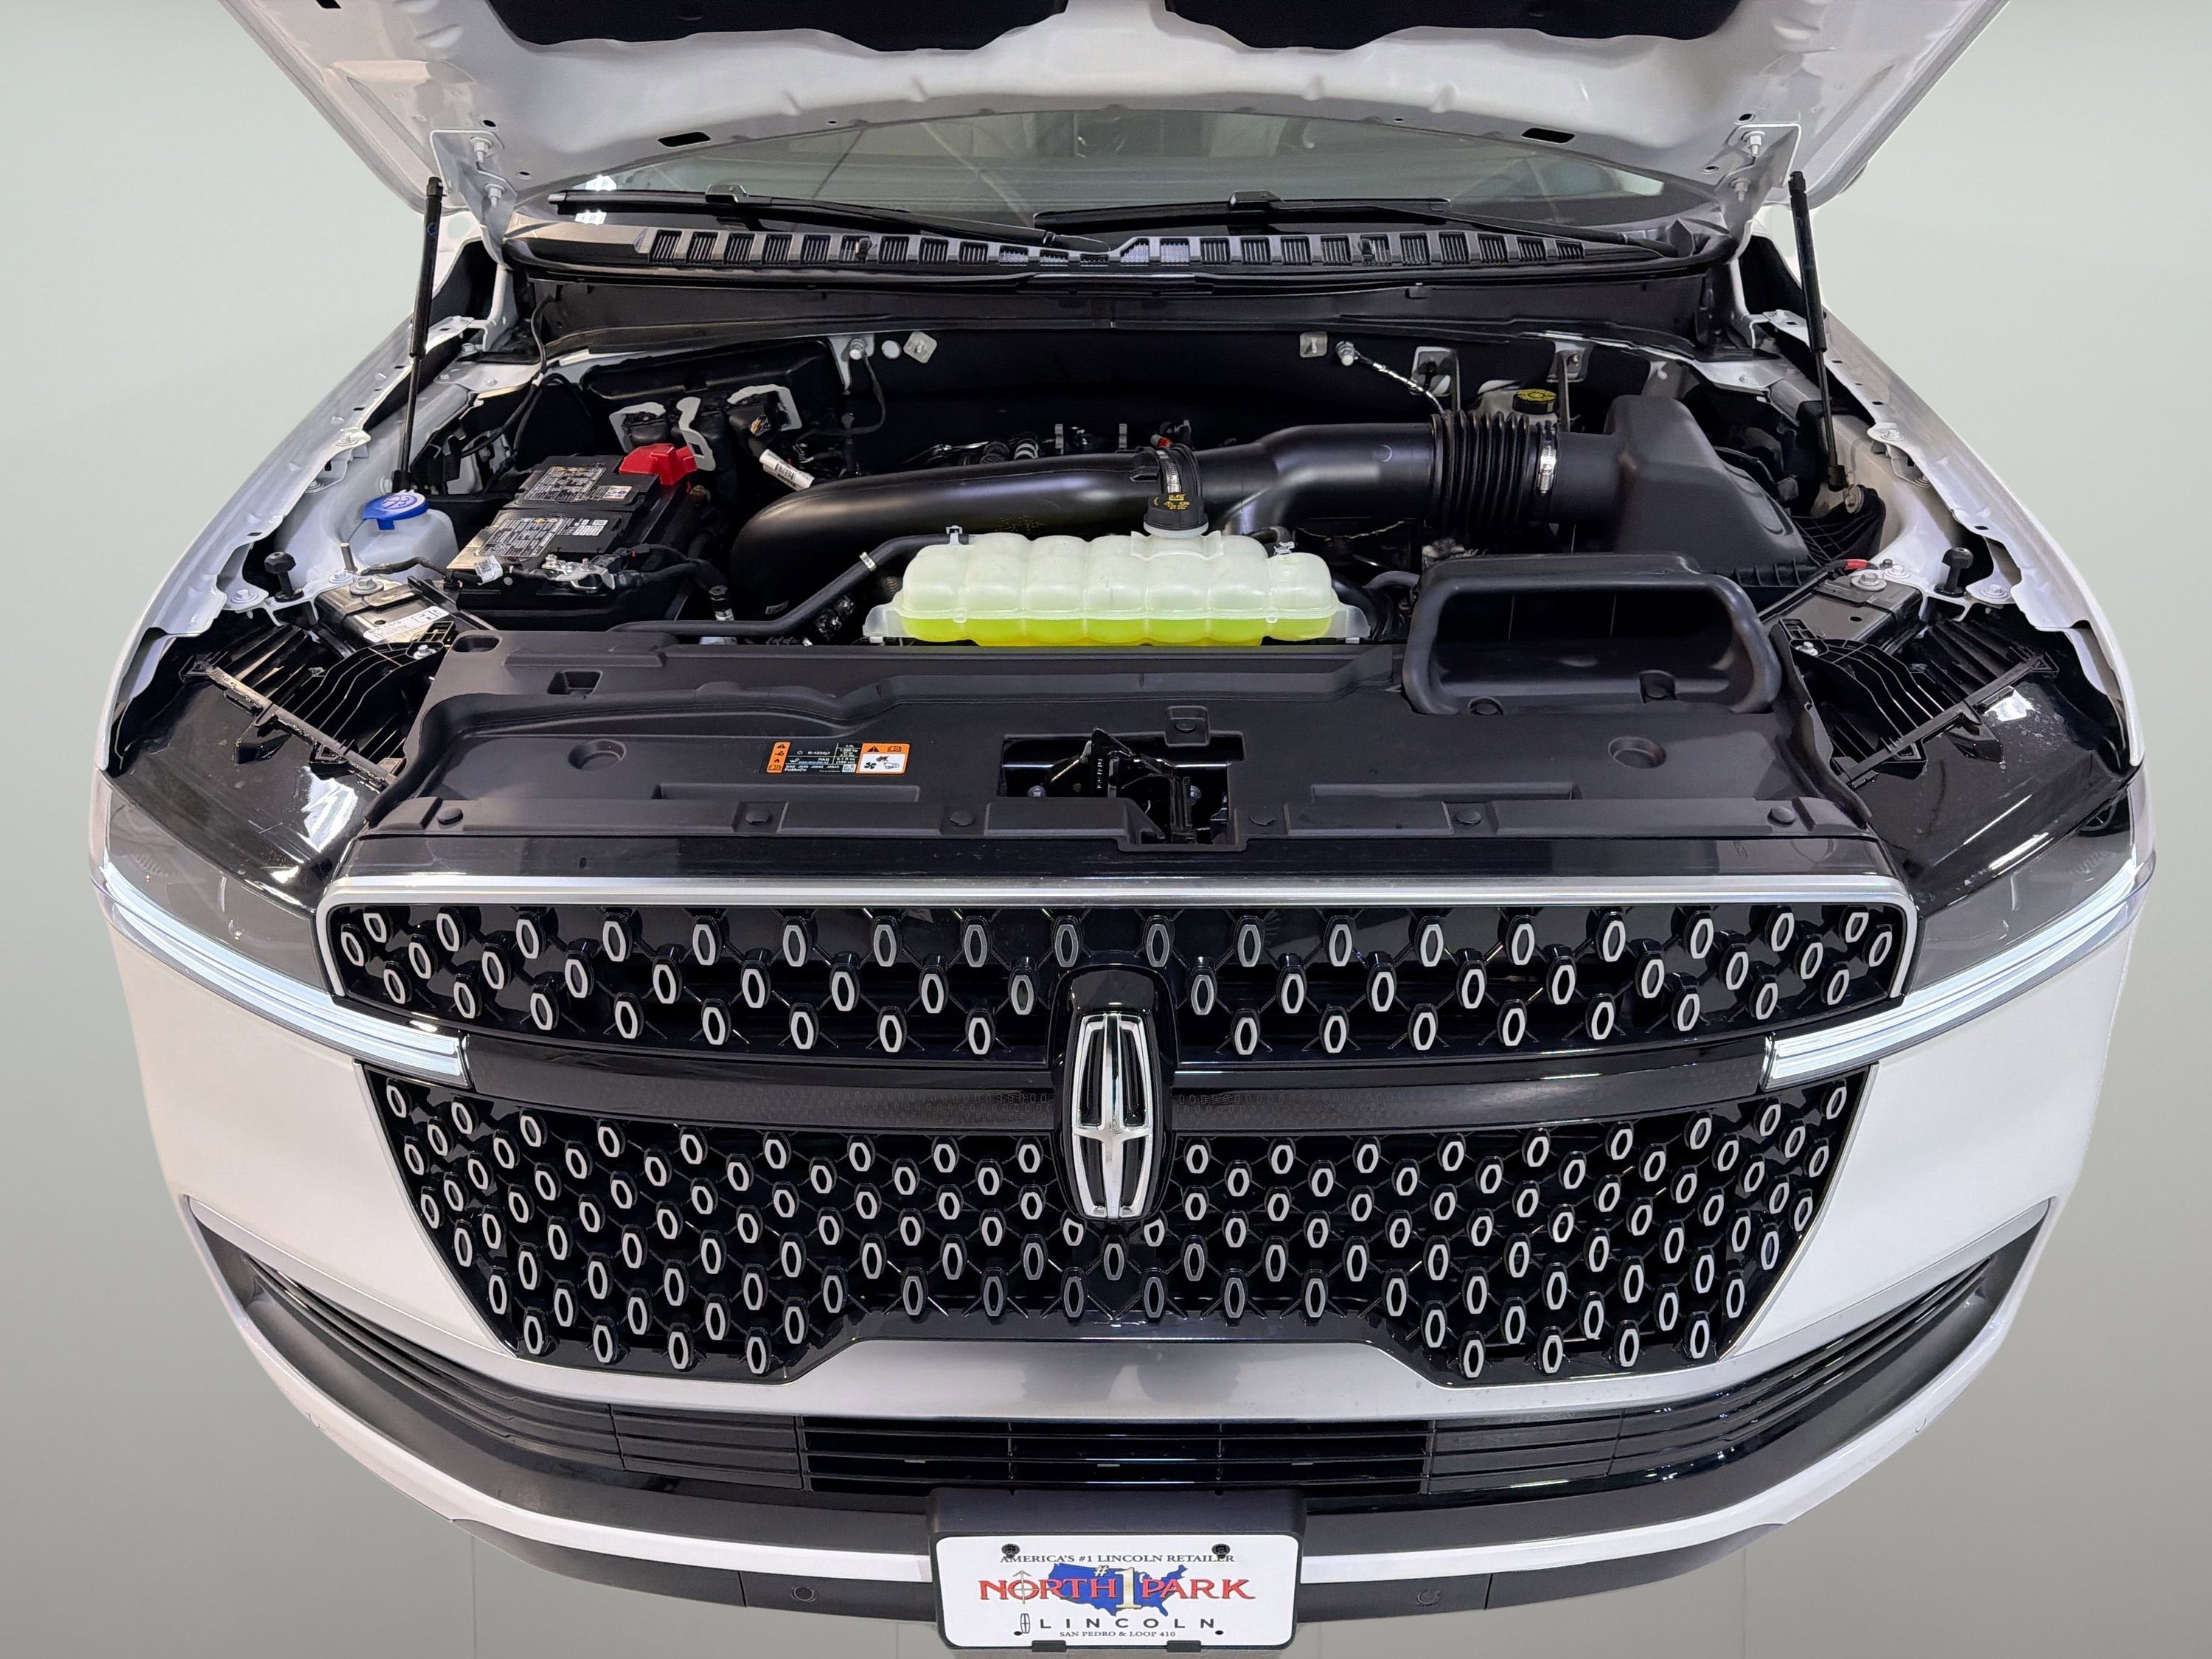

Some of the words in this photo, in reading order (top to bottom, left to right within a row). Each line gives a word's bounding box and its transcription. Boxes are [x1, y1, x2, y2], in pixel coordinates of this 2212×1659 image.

[1000, 1554, 1075, 1562] AMERICA'S
[1097, 1554, 1163, 1562] LINCOLN
[978, 1578, 1117, 1600] NORTH
[1142, 1579, 1256, 1600] PARK
[1039, 1618, 1215, 1629] LINCOLN
